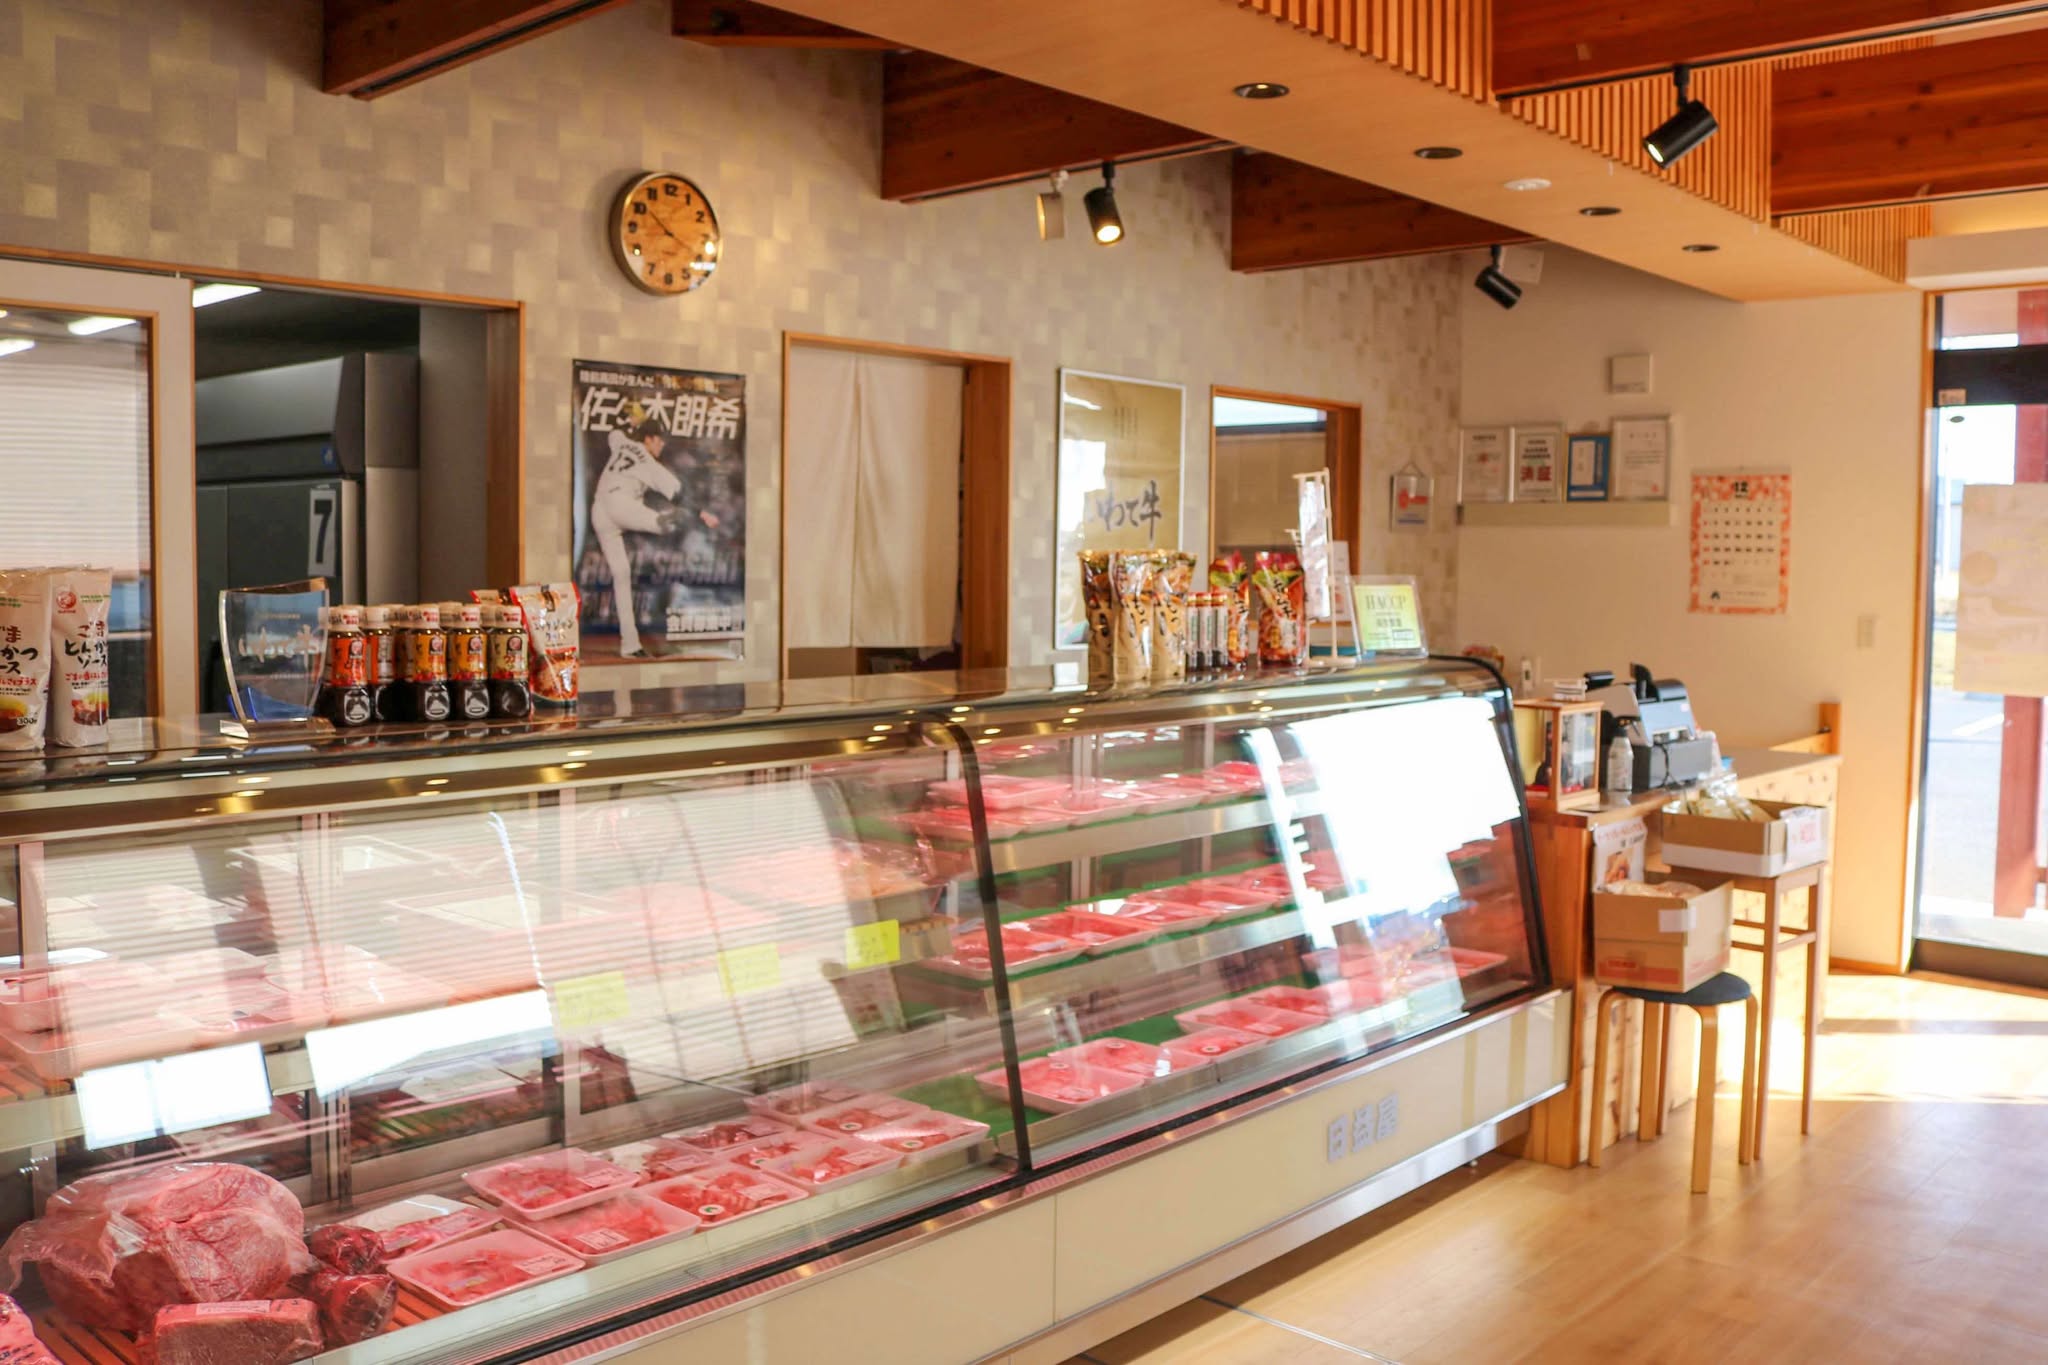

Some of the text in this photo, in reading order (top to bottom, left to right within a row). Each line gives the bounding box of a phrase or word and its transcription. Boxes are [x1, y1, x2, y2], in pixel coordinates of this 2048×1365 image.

[647, 187, 658, 201] 11
[664, 183, 678, 196] 12
[685, 192, 692, 206] 1
[633, 202, 647, 215] 10
[695, 211, 705, 223] 2
[647, 262, 656, 275] 7
[681, 267, 691, 279] 5
[1087, 479, 1162, 541] わて牛
[314, 499, 333, 564] 7
[0, 625, 22, 644] ま
